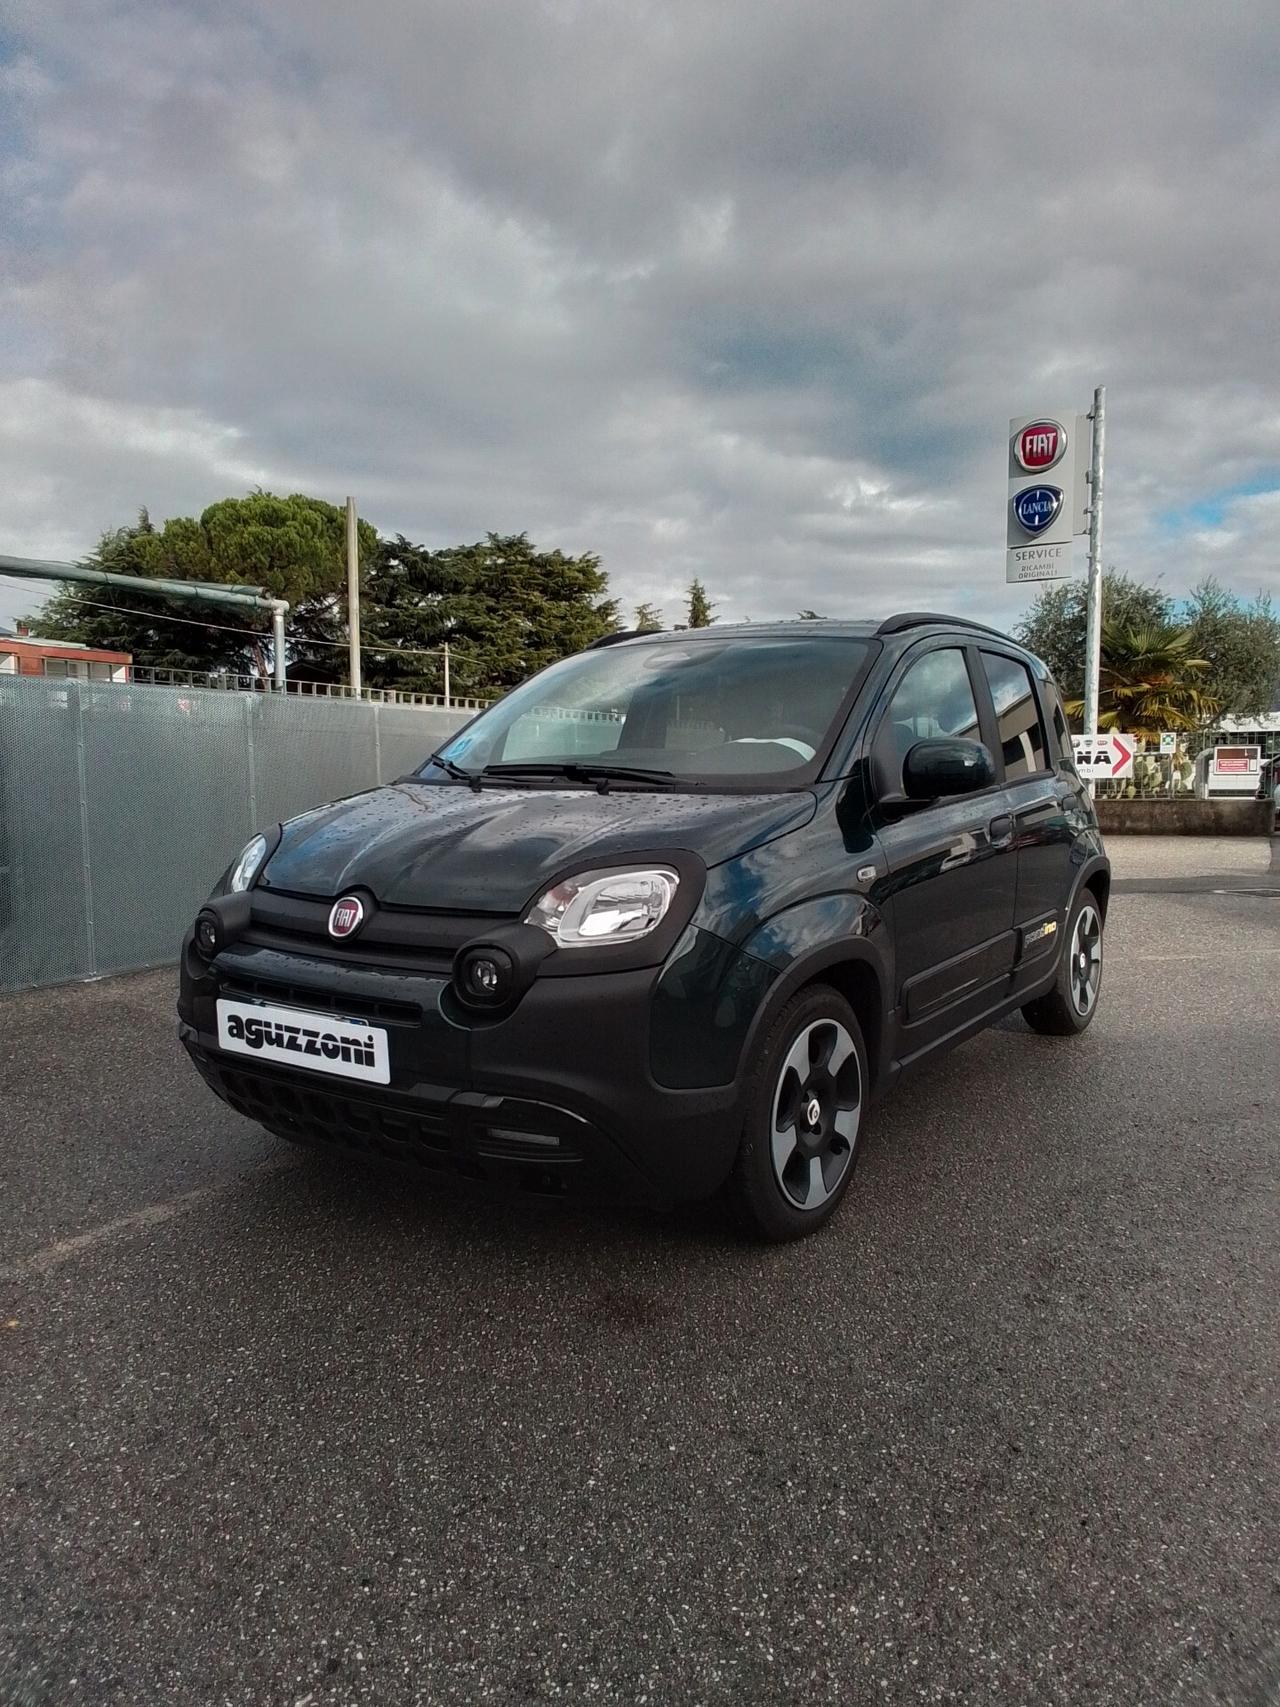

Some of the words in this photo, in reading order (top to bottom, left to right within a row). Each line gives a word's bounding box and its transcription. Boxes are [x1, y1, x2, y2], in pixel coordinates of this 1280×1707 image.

[1025, 432, 1056, 459] FIAT
[1023, 500, 1052, 515] LANCIA
[1015, 548, 1062, 561] SERVICE
[334, 908, 356, 928] FIAT
[227, 1014, 376, 1068] aguzzoni
